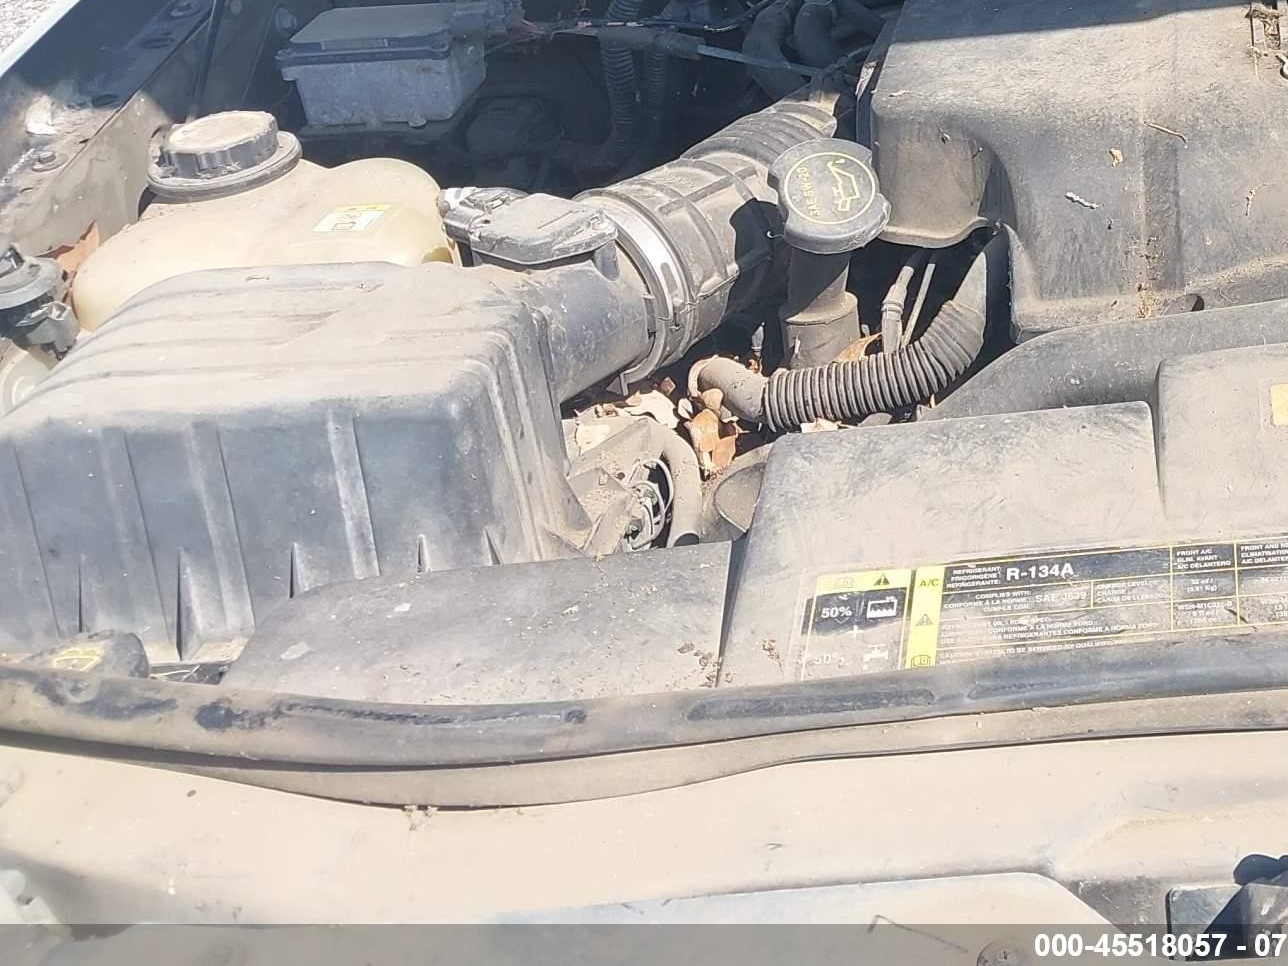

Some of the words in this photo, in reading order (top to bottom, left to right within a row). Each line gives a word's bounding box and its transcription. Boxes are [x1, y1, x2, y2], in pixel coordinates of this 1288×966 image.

[1190, 560, 1231, 568] DELANTERO
[1006, 563, 1074, 581] R-134A
[920, 578, 939, 587] A/C
[1036, 594, 1058, 603] SAE
[821, 606, 852, 618] 50%
